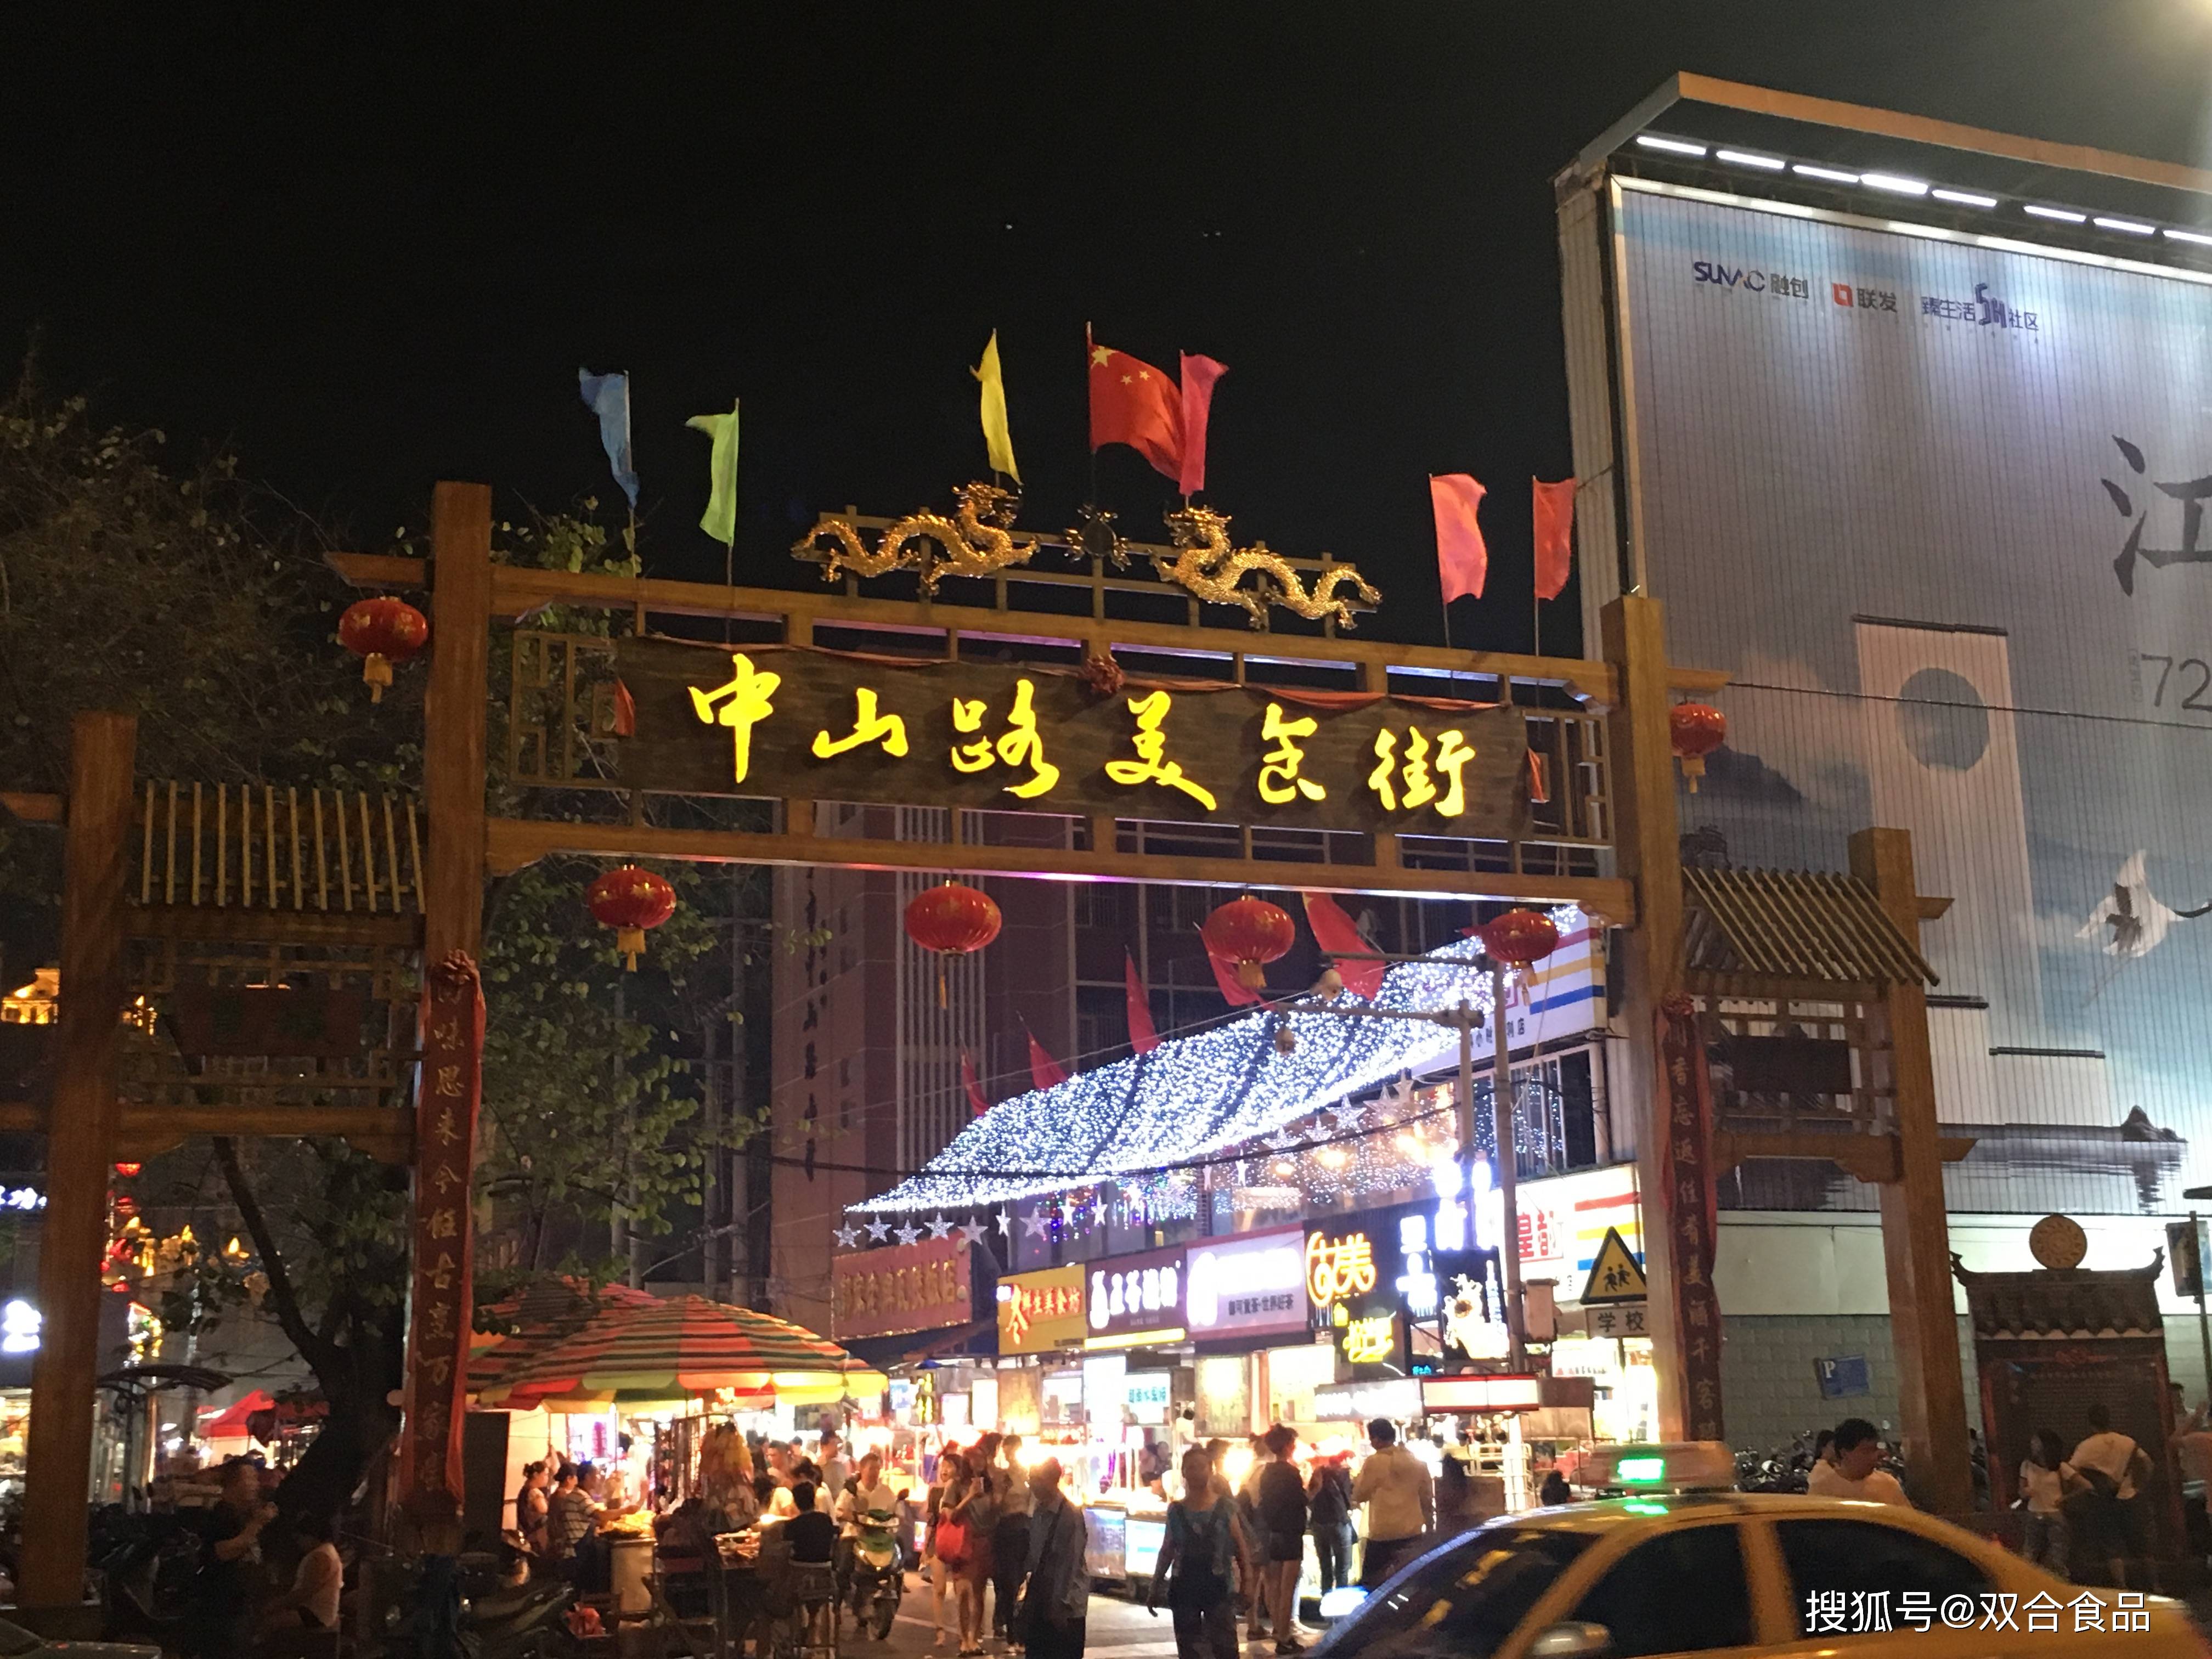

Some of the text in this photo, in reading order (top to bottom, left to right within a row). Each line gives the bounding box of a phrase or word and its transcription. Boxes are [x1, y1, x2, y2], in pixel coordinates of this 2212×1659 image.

[1694, 261, 1809, 299] SUNAC 融创
[1857, 287, 1898, 313] 联发
[687, 652, 1476, 817] 中山路美食街
[1598, 1311, 1645, 1333] 学校
[1824, 1361, 1836, 1379] P
